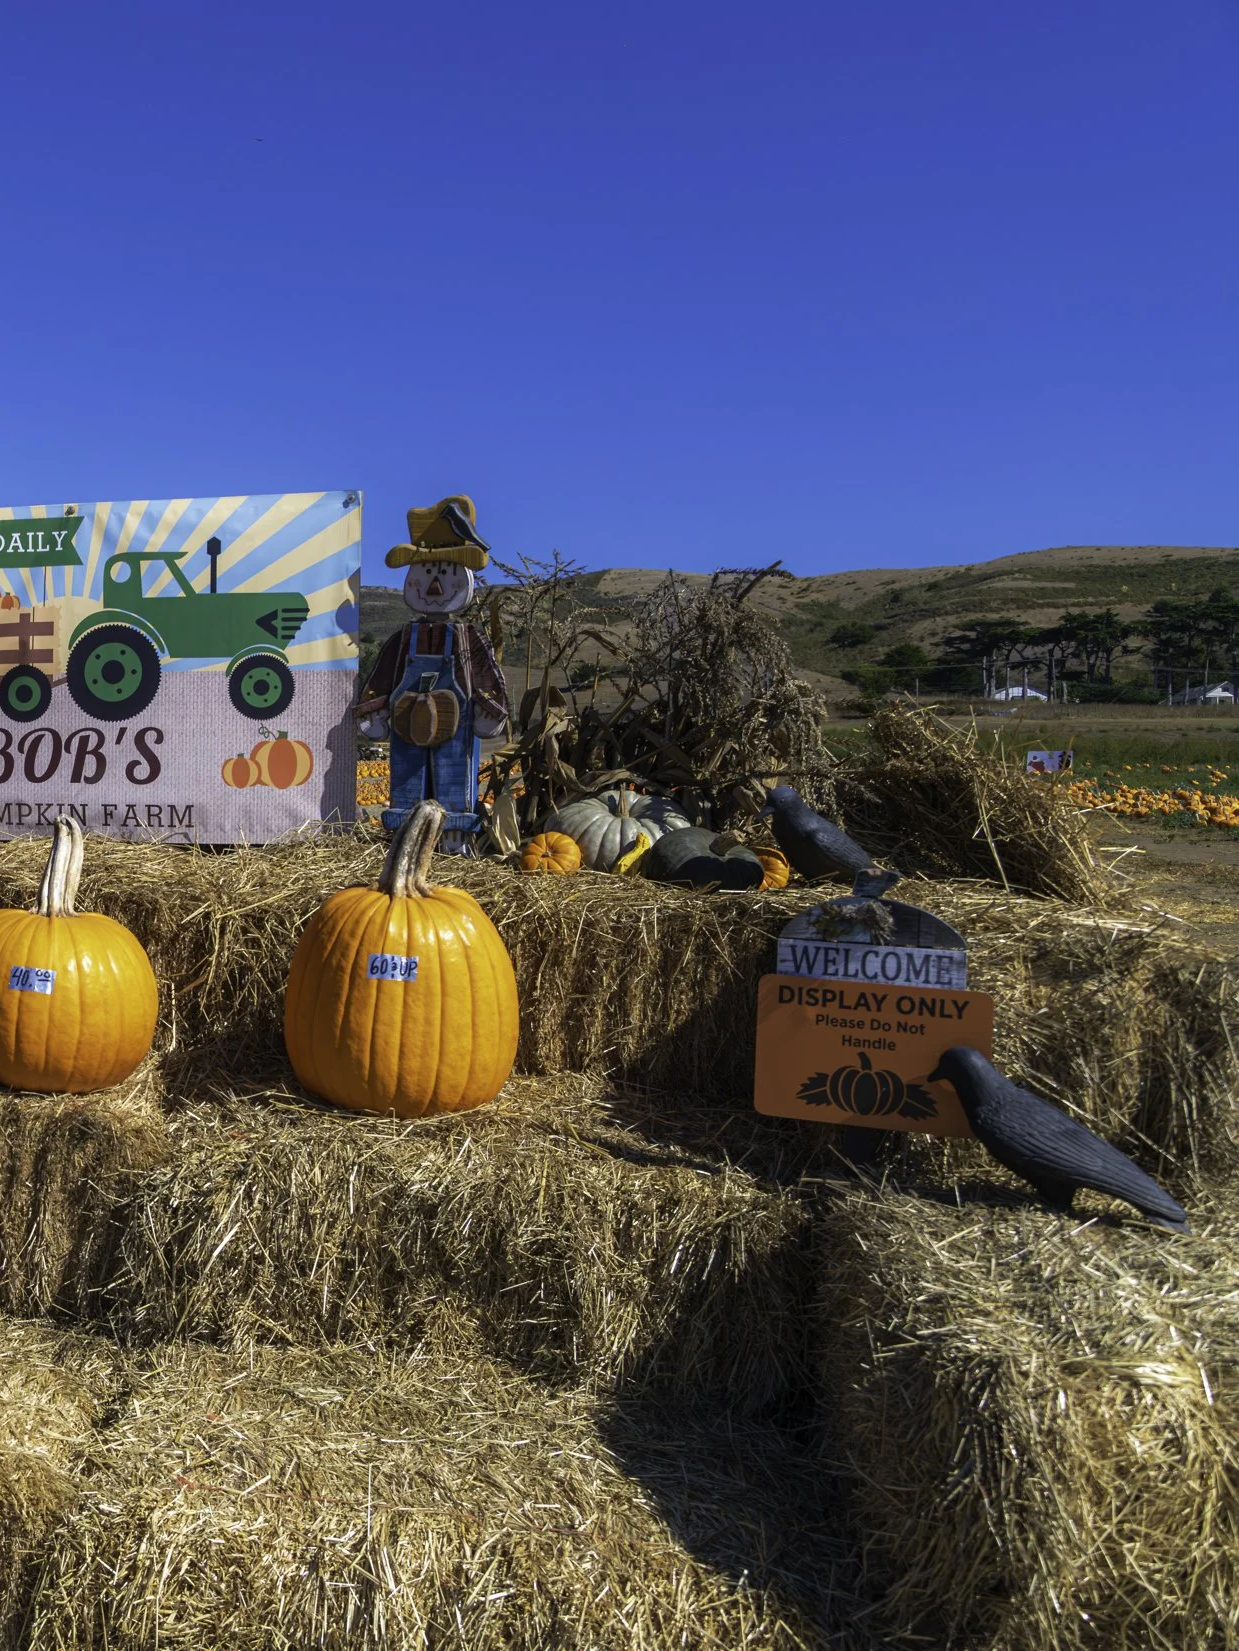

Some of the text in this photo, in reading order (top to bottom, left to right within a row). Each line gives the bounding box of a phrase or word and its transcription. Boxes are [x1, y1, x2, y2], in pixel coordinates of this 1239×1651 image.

[101, 804, 195, 828] FARM
[370, 956, 389, 975] 60
[399, 961, 418, 978] UP
[789, 945, 955, 985] WELCOME
[778, 985, 970, 1020] DISPLAY ONLY
[815, 1014, 926, 1036] Please Do Not
[841, 1035, 897, 1051] Handle
